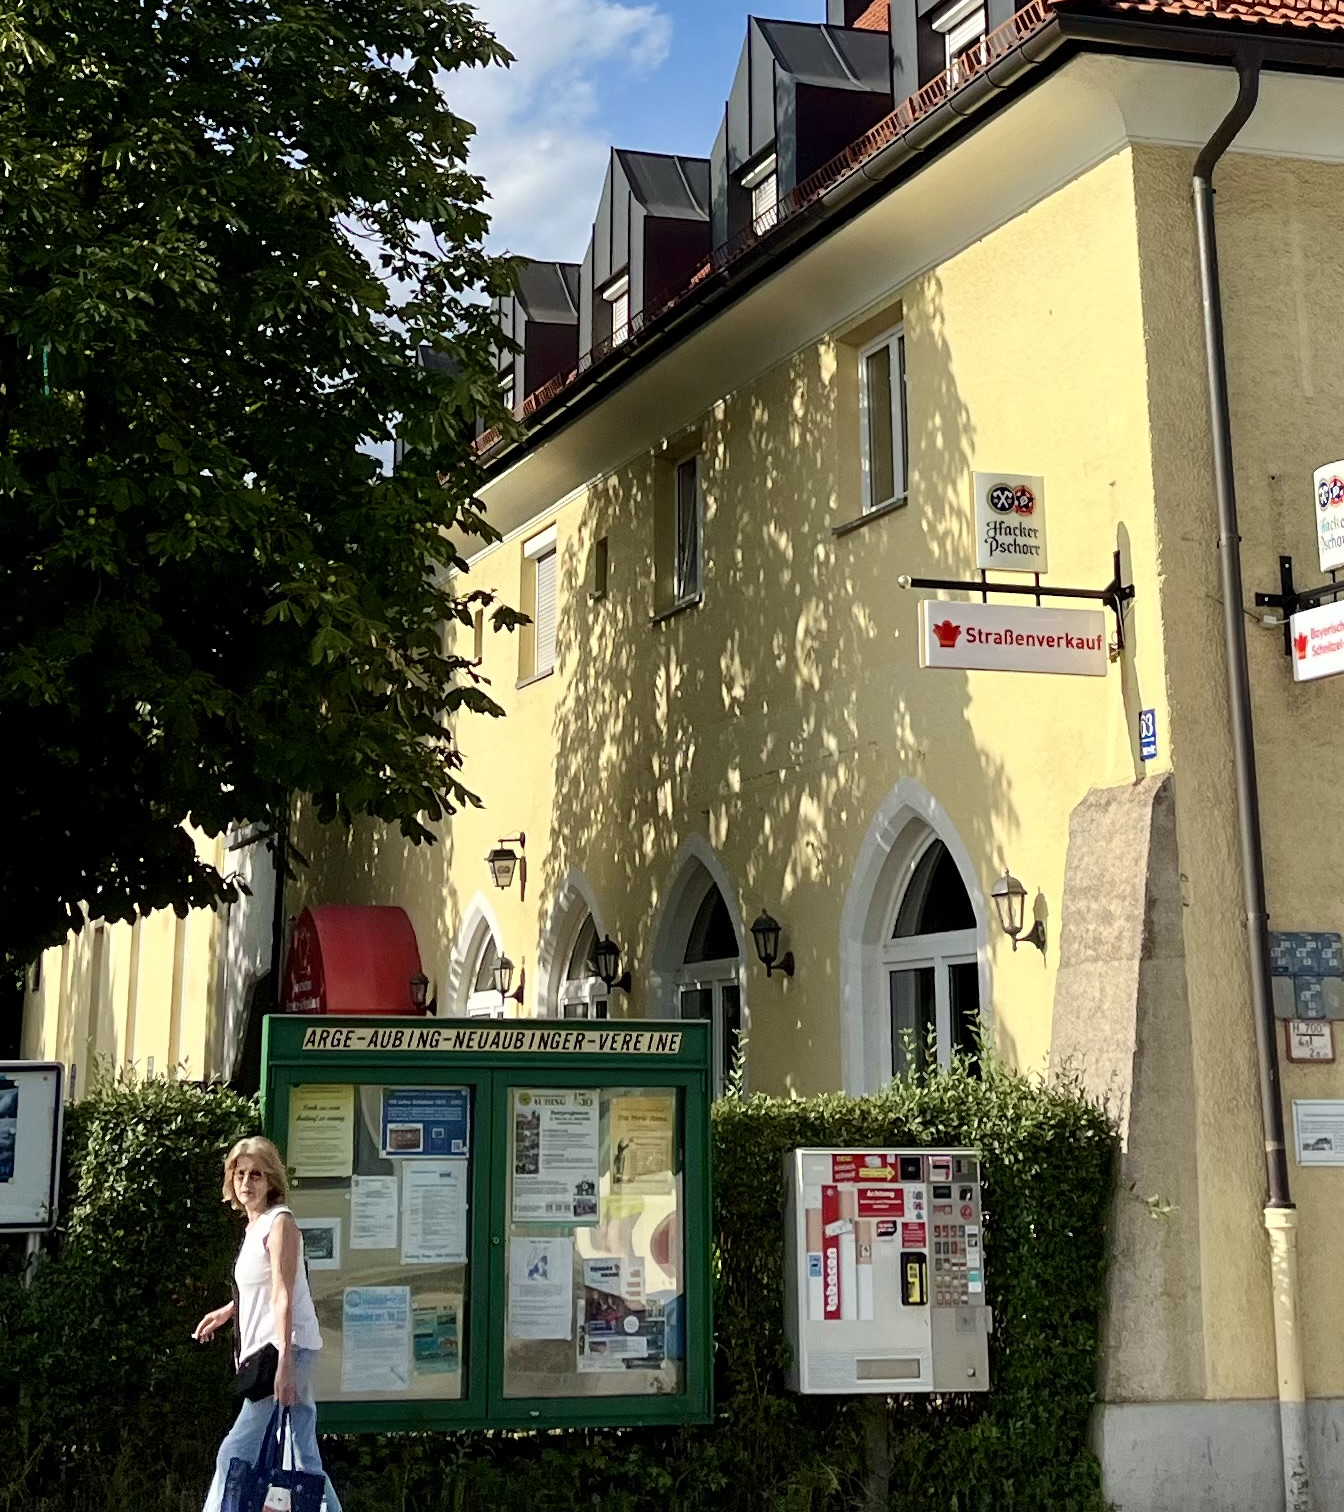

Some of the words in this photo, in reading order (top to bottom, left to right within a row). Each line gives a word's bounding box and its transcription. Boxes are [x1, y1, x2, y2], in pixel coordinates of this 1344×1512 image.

[986, 520, 1039, 539] Hacker
[984, 536, 1040, 557] Pschorr
[966, 627, 1102, 651] Straßenverkauf
[1292, 1022, 1299, 1033] H
[1305, 1023, 1323, 1033] 700
